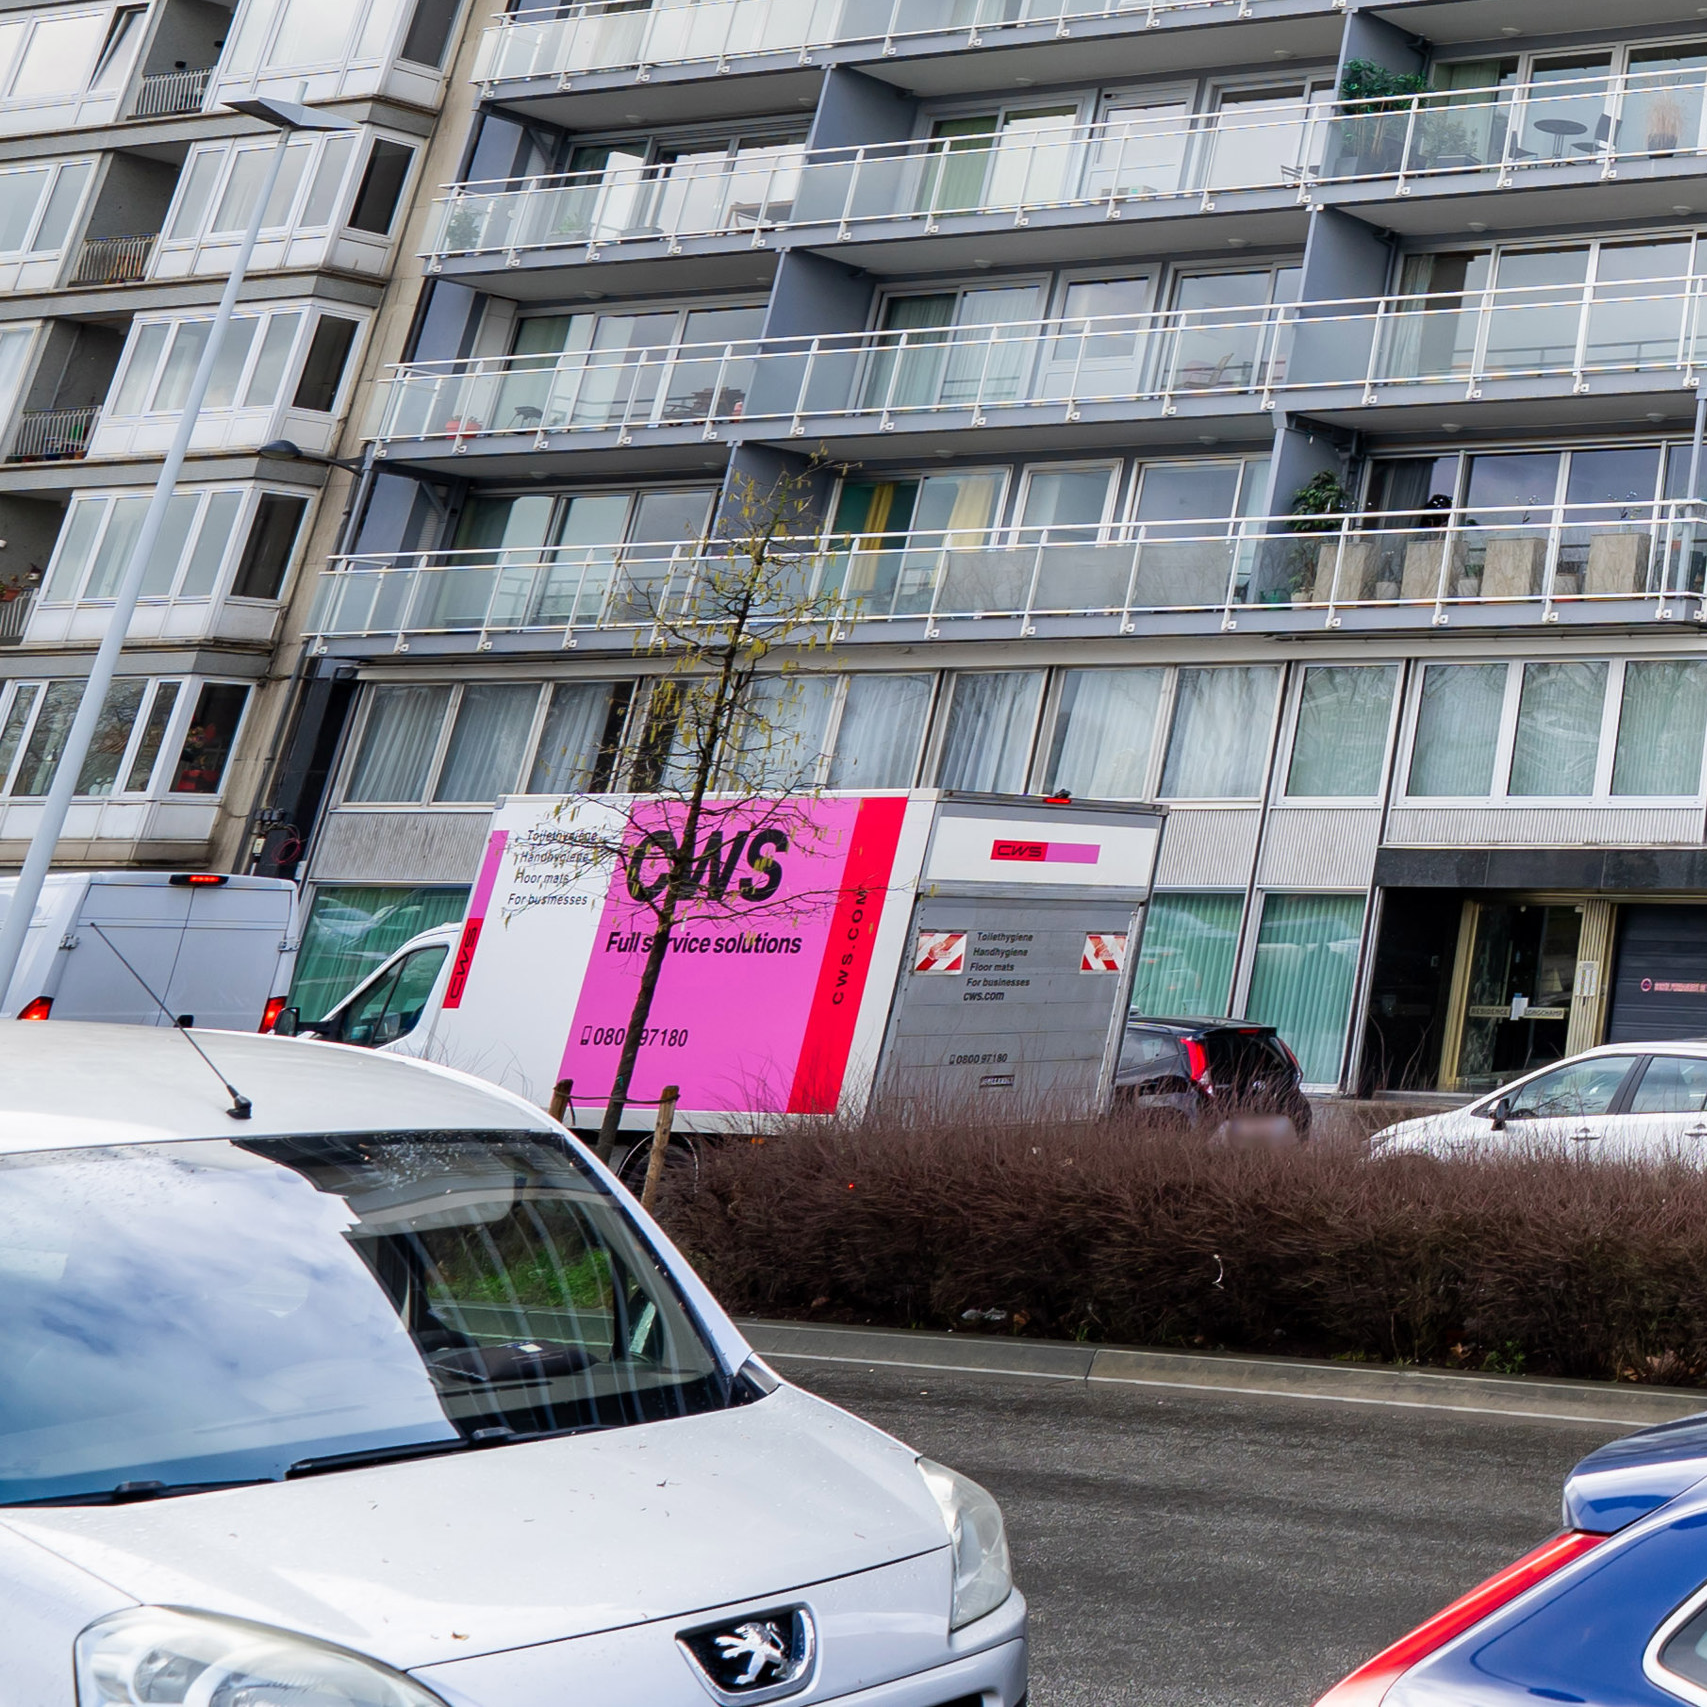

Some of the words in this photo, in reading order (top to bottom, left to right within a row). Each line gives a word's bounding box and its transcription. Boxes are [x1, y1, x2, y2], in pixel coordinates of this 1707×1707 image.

[998, 845, 1042, 857] CWS
[627, 829, 789, 902] CWS
[543, 874, 570, 884] mats
[508, 893, 526, 905] For
[528, 894, 588, 905] businesses
[605, 931, 641, 953] Full
[641, 932, 711, 954] srvice
[713, 932, 802, 954] solutions
[977, 932, 1033, 943] Toilethygiene
[832, 889, 867, 1005] CWS.COM
[973, 947, 1028, 958] Handhygiene
[450, 927, 478, 999] CWS
[970, 962, 992, 971] Floor
[994, 963, 1015, 971] mats
[966, 978, 981, 986] For
[983, 978, 1030, 987] businesses
[963, 992, 1005, 1001] cws.com
[640, 1028, 688, 1047] 97180
[956, 1055, 980, 1064] 0800
[980, 1054, 1008, 1063] 97180
